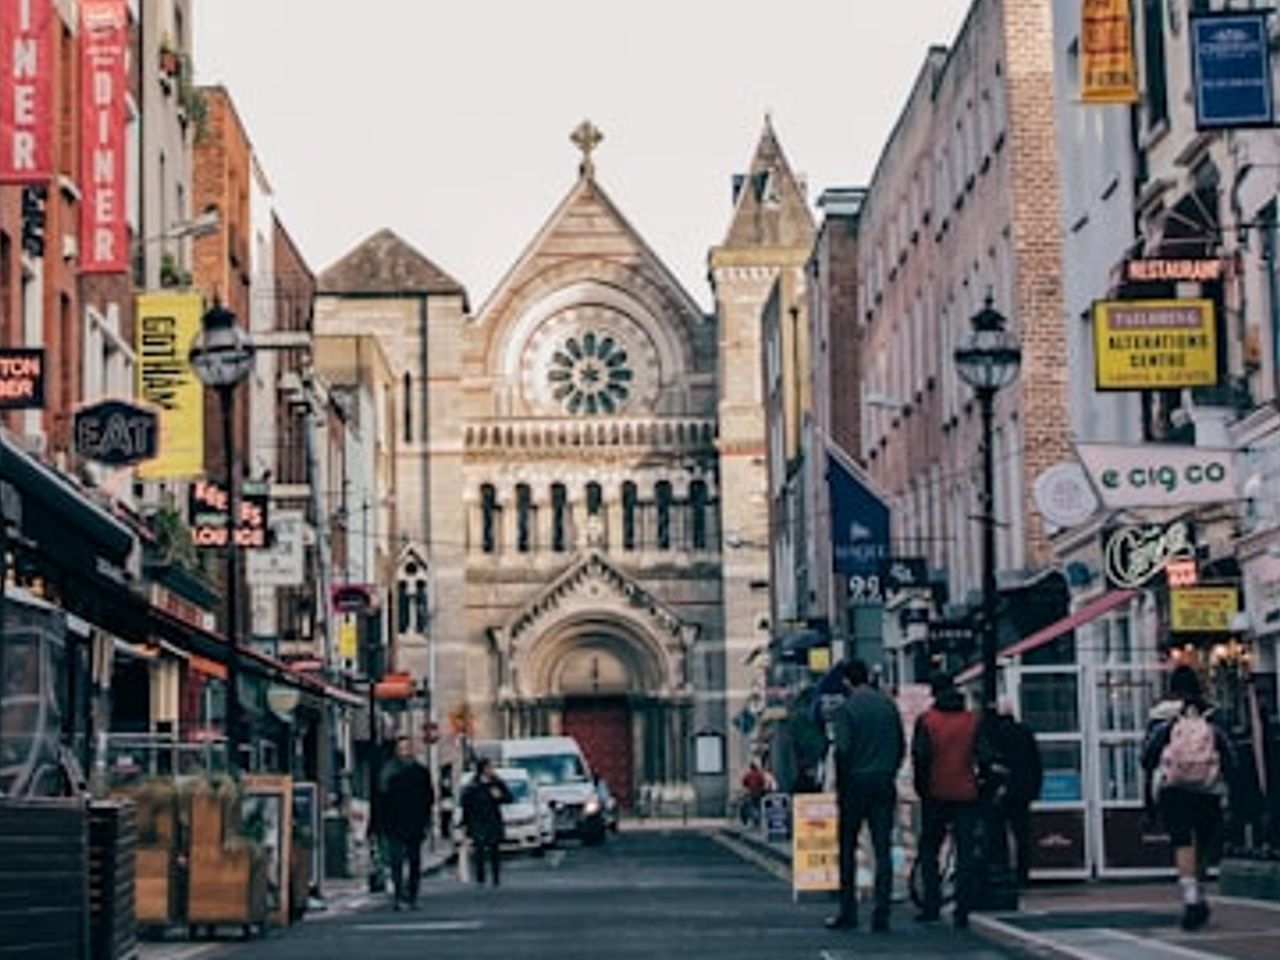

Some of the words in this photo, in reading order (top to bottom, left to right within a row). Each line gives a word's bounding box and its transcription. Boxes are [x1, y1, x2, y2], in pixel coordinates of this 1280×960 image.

[92, 70, 116, 262] DINER
[141, 316, 190, 411] GOTHAM
[76, 412, 153, 455] EAT
[1101, 469, 1120, 489] e
[1128, 464, 1177, 492] cig
[1185, 462, 1226, 484] co
